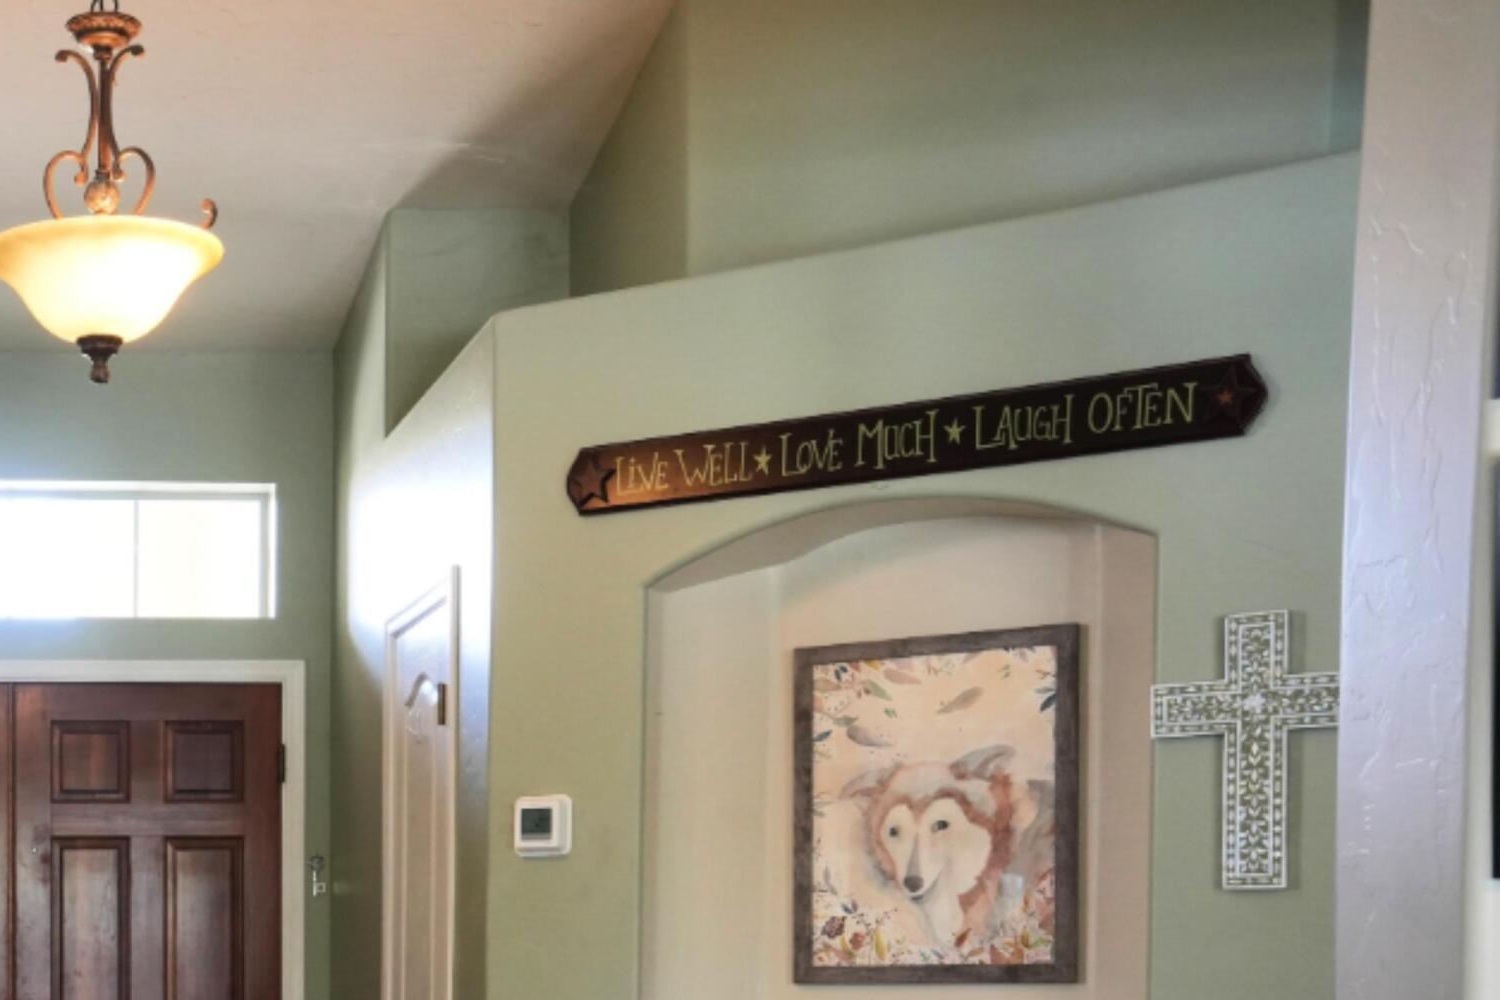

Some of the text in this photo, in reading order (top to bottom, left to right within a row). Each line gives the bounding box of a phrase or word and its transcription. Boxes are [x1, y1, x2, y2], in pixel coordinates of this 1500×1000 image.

[674, 441, 752, 487] WELL
[779, 428, 843, 477] LOVE
[855, 408, 939, 470] MUCH
[972, 394, 1075, 449] LAUGH
[1088, 382, 1198, 434] OFTEN
